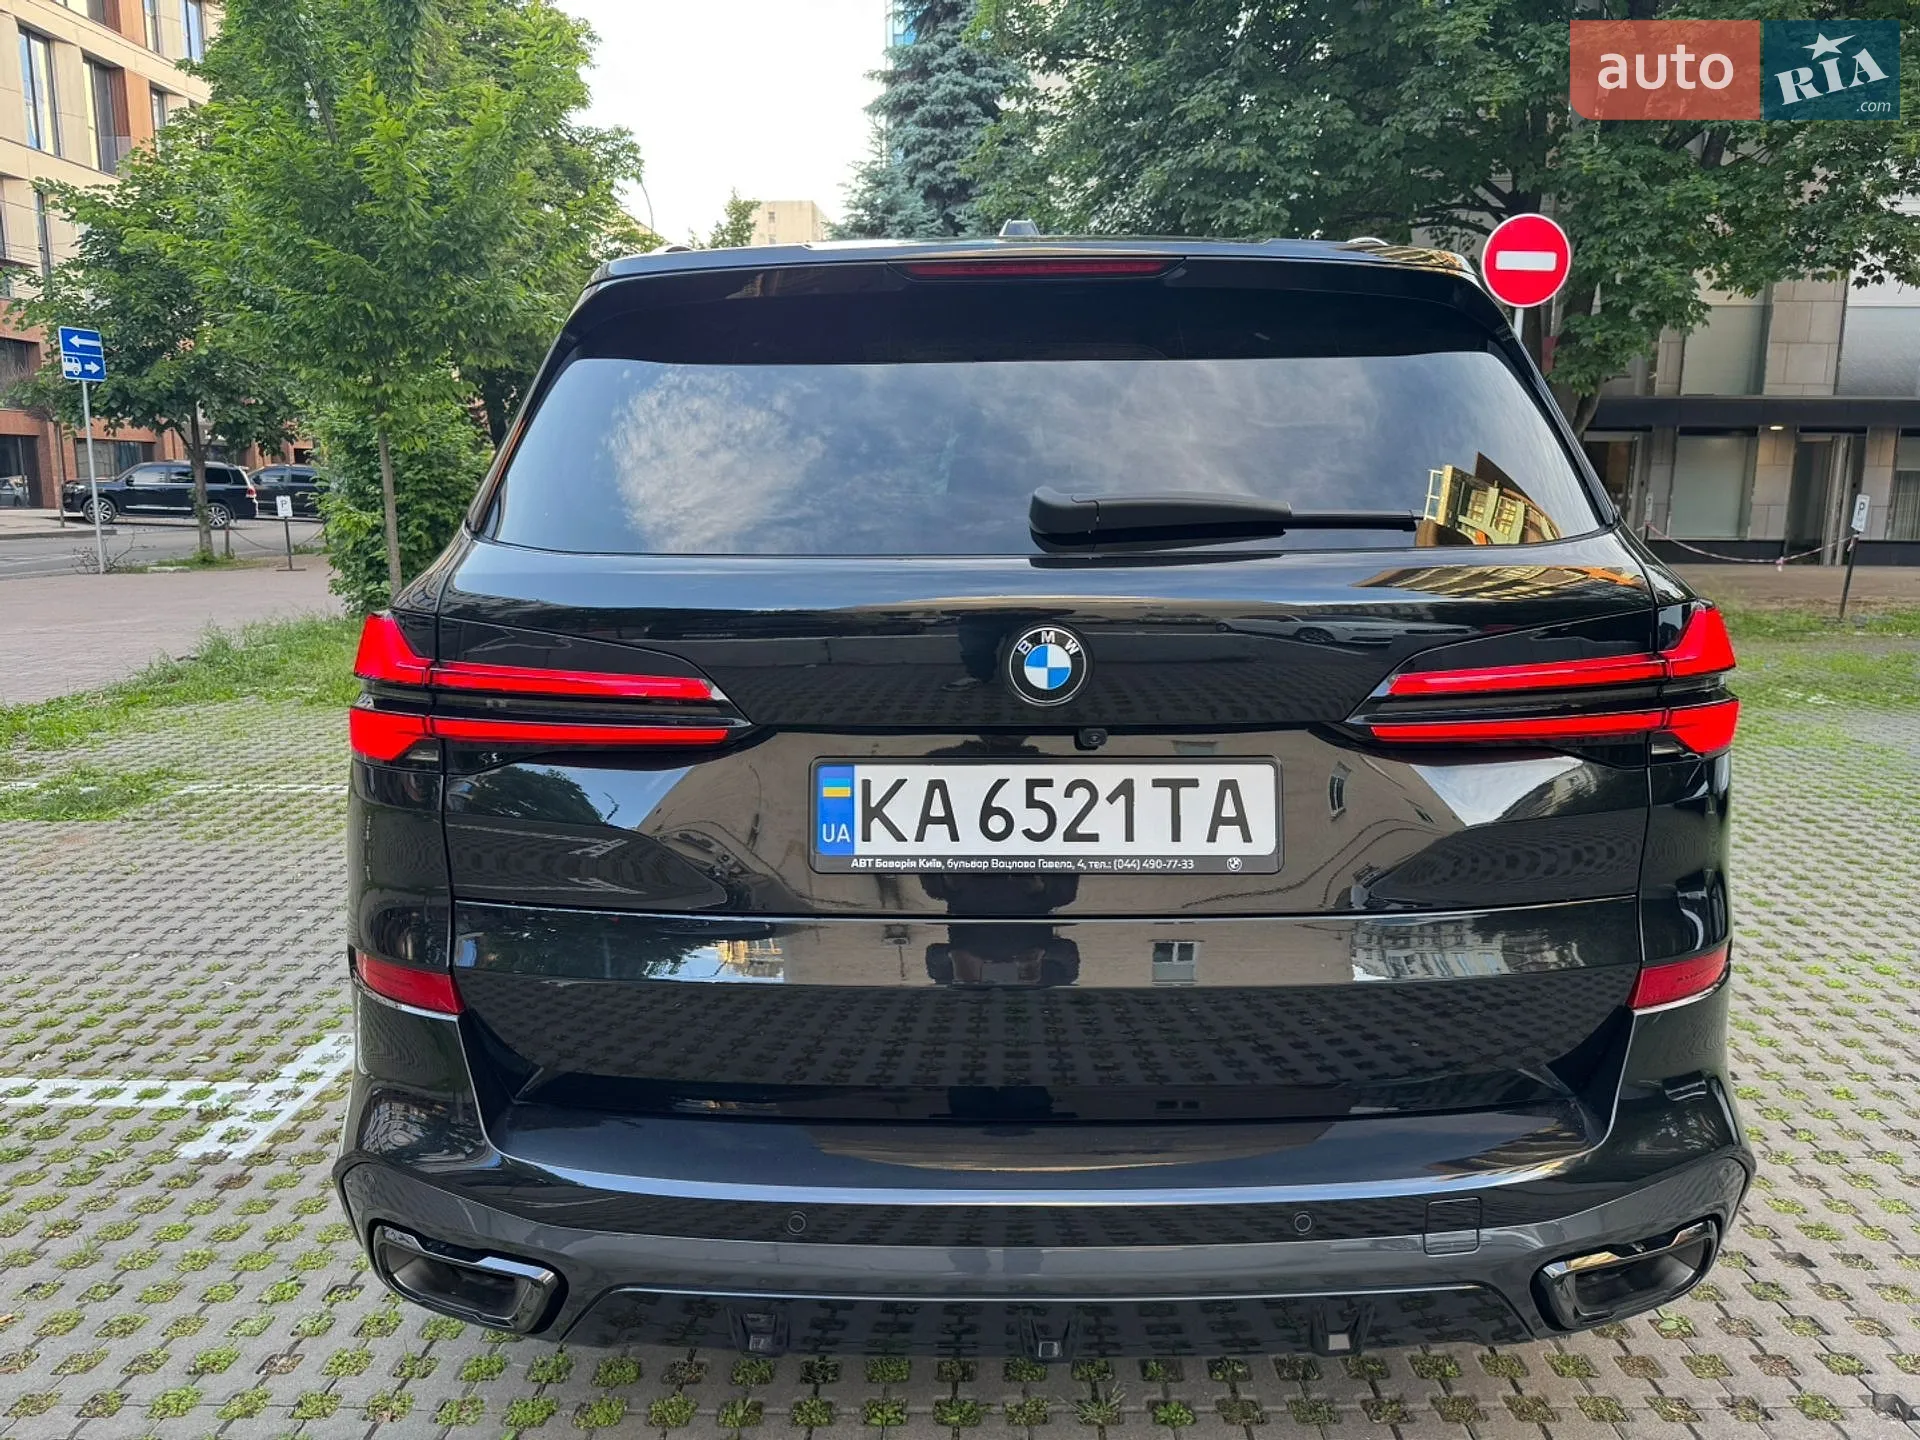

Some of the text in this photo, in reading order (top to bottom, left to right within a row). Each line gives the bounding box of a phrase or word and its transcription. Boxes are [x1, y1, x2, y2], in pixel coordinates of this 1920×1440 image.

[1018, 630, 1080, 655] BMW
[861, 778, 1253, 843] KA 6521 TA
[822, 823, 851, 843] UA
[851, 858, 874, 868] АВТ
[918, 857, 945, 870] Київ,
[946, 858, 989, 870] бульвар
[1077, 859, 1087, 870] 4,
[1088, 860, 1112, 869] тел.:
[1113, 858, 1140, 871] (044)
[1142, 859, 1195, 870] 490-77-33
